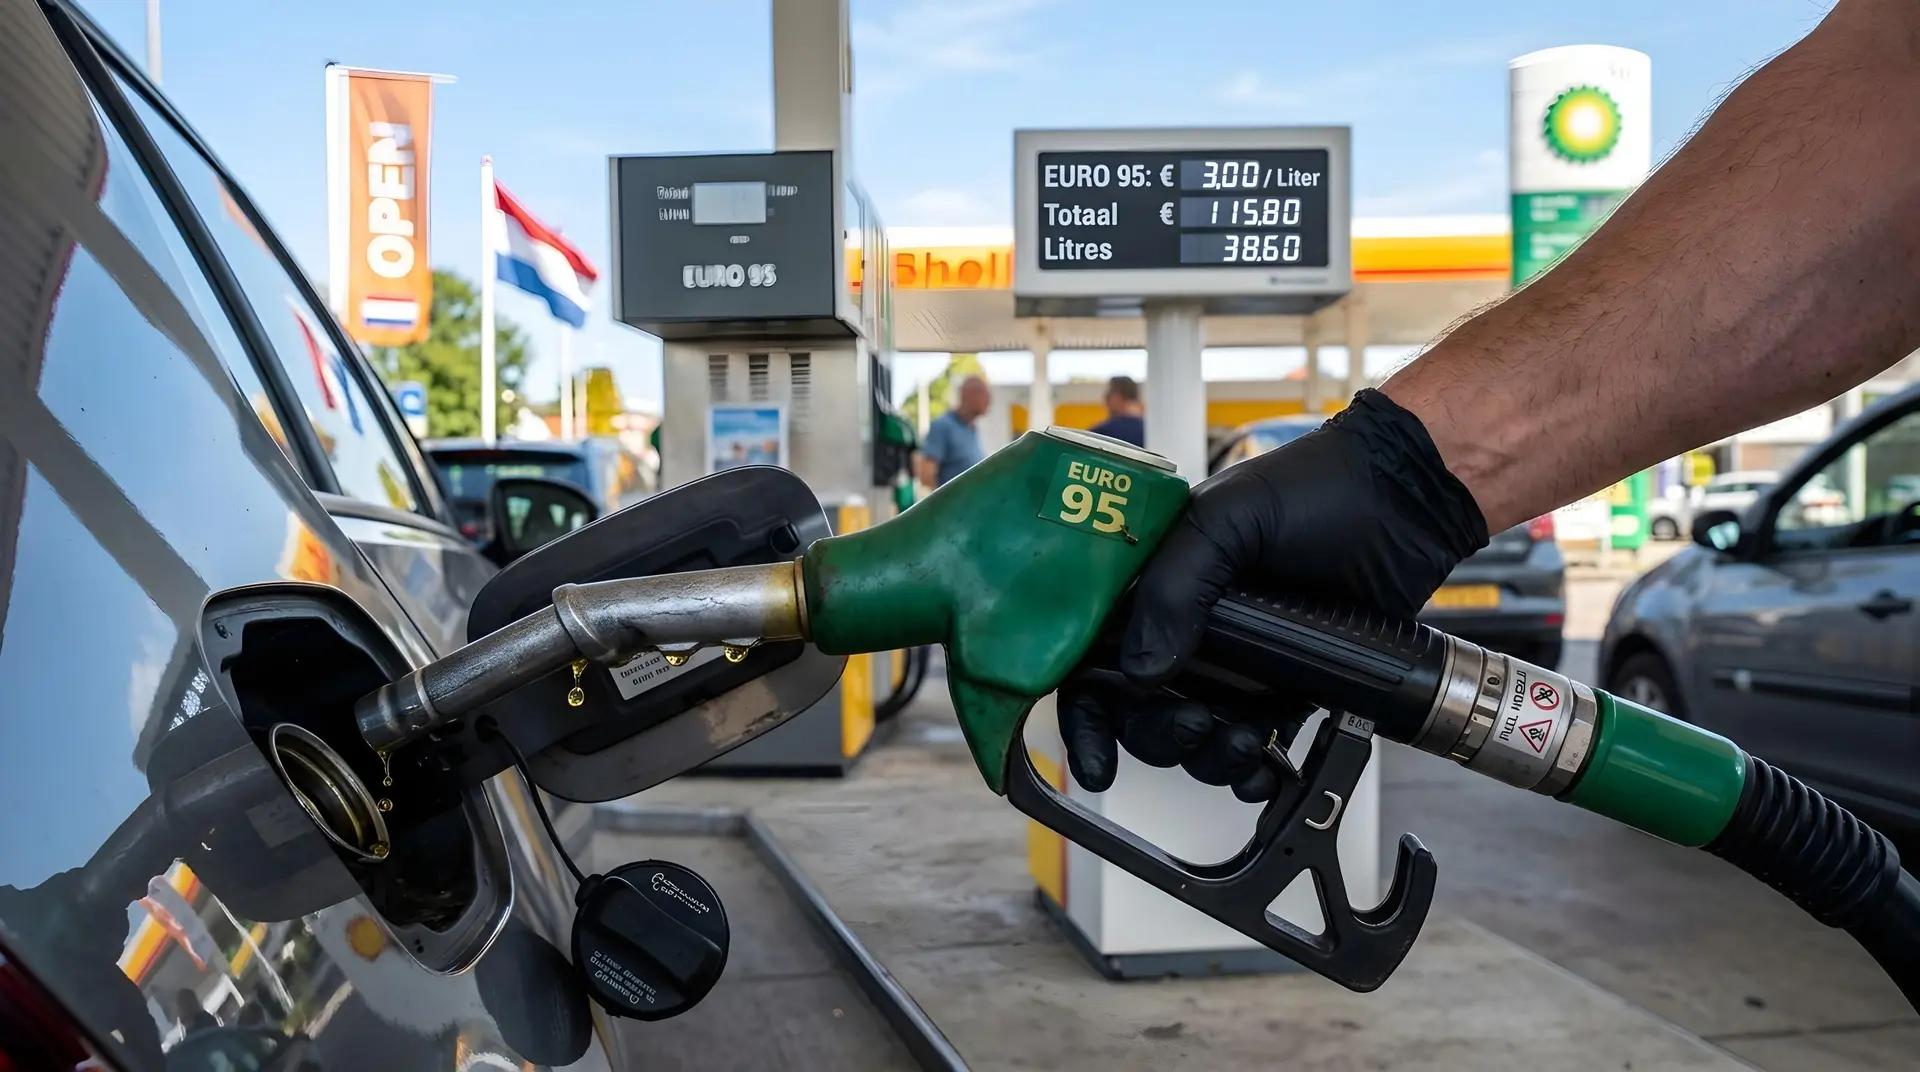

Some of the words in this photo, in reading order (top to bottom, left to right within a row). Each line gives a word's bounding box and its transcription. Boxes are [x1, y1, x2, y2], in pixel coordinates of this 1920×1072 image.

[1044, 164, 1110, 188] EURO
[1117, 164, 1152, 188] 95:
[1277, 167, 1321, 187] Liter
[367, 121, 415, 279] OPEN
[1043, 202, 1118, 226] Totaal
[1044, 236, 1113, 261] Litres
[682, 264, 746, 289] EURO
[747, 263, 778, 288] 95
[1067, 461, 1132, 493] EURO
[1059, 484, 1126, 533] 95
